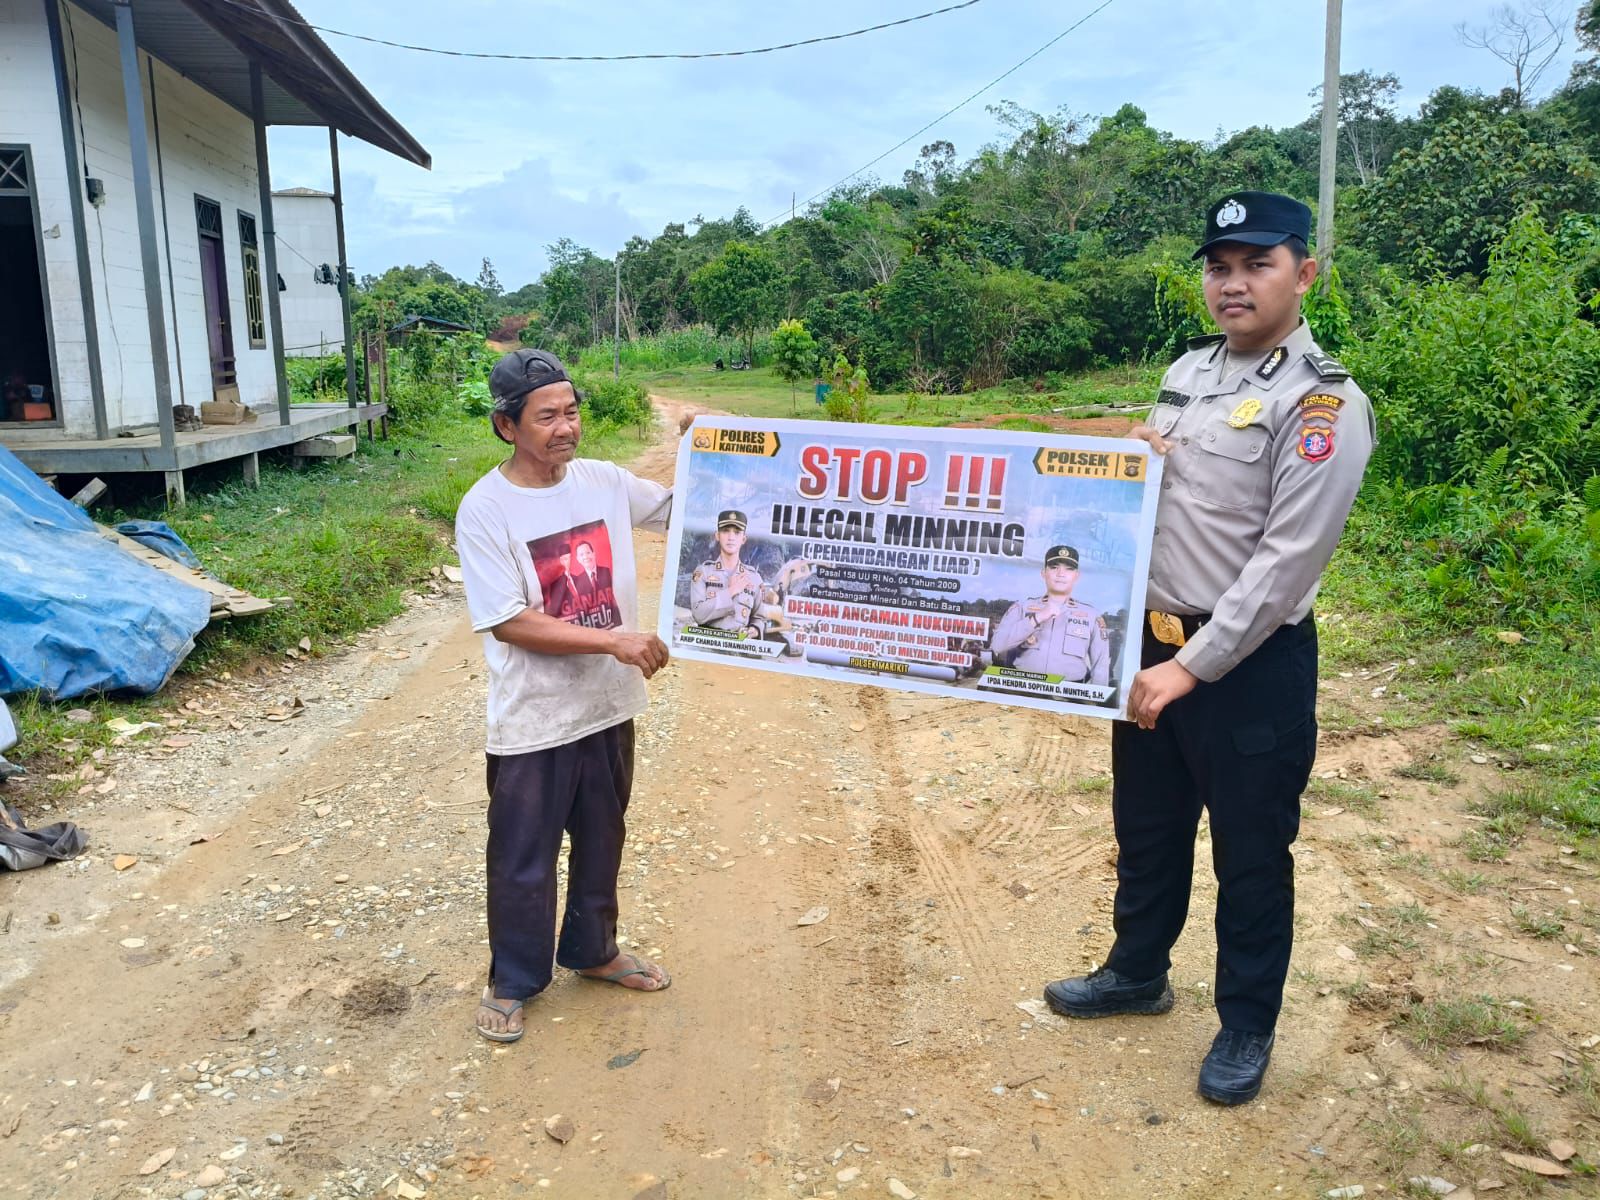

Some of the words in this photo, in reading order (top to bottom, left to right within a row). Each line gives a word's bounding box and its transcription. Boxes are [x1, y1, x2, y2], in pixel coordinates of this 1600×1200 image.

[720, 429, 765, 444] POLRES
[719, 442, 765, 454] KATINGAN
[1047, 451, 1109, 467] POLSEK
[798, 444, 928, 504] STOP
[944, 454, 1008, 511] !!!
[1047, 464, 1107, 476] MARIKIT
[770, 503, 877, 544] ILLEGAL
[883, 513, 1026, 557] MINNING
[820, 568, 841, 577] Pasal
[843, 570, 856, 579] 158
[858, 572, 870, 581] UU
[873, 574, 881, 582] RI
[883, 575, 896, 584] No.
[898, 576, 908, 585] 04
[910, 577, 935, 587] Tahun
[937, 580, 958, 590] 2009
[812, 587, 868, 601] Pertambangan
[870, 594, 899, 605] Mineral
[901, 597, 917, 607] Dan
[920, 599, 939, 609] Batu
[941, 602, 961, 612] Bara
[787, 599, 839, 618] DENGAN
[842, 605, 909, 627] ANCAMAN
[912, 614, 986, 637] HUKUMAN
[1067, 618, 1090, 626] POLRI
[695, 637, 722, 647] CHANDRA
[819, 623, 830, 633] 10
[831, 624, 858, 637] TAHUN
[859, 627, 896, 641] PENJARA
[897, 632, 915, 644] DAN
[916, 635, 946, 648] DENDA
[898, 646, 929, 660] MILYAR
[850, 657, 877, 670] POLSEK
[878, 661, 909, 673] MARIKIT
[987, 676, 1001, 686] IPDA
[1002, 679, 1027, 689] HENDRA
[1028, 682, 1054, 693] SOPIYAN
[1055, 686, 1062, 694] D.
[1063, 687, 1091, 699] MUNTHE,
[1092, 690, 1105, 700] S.H.
